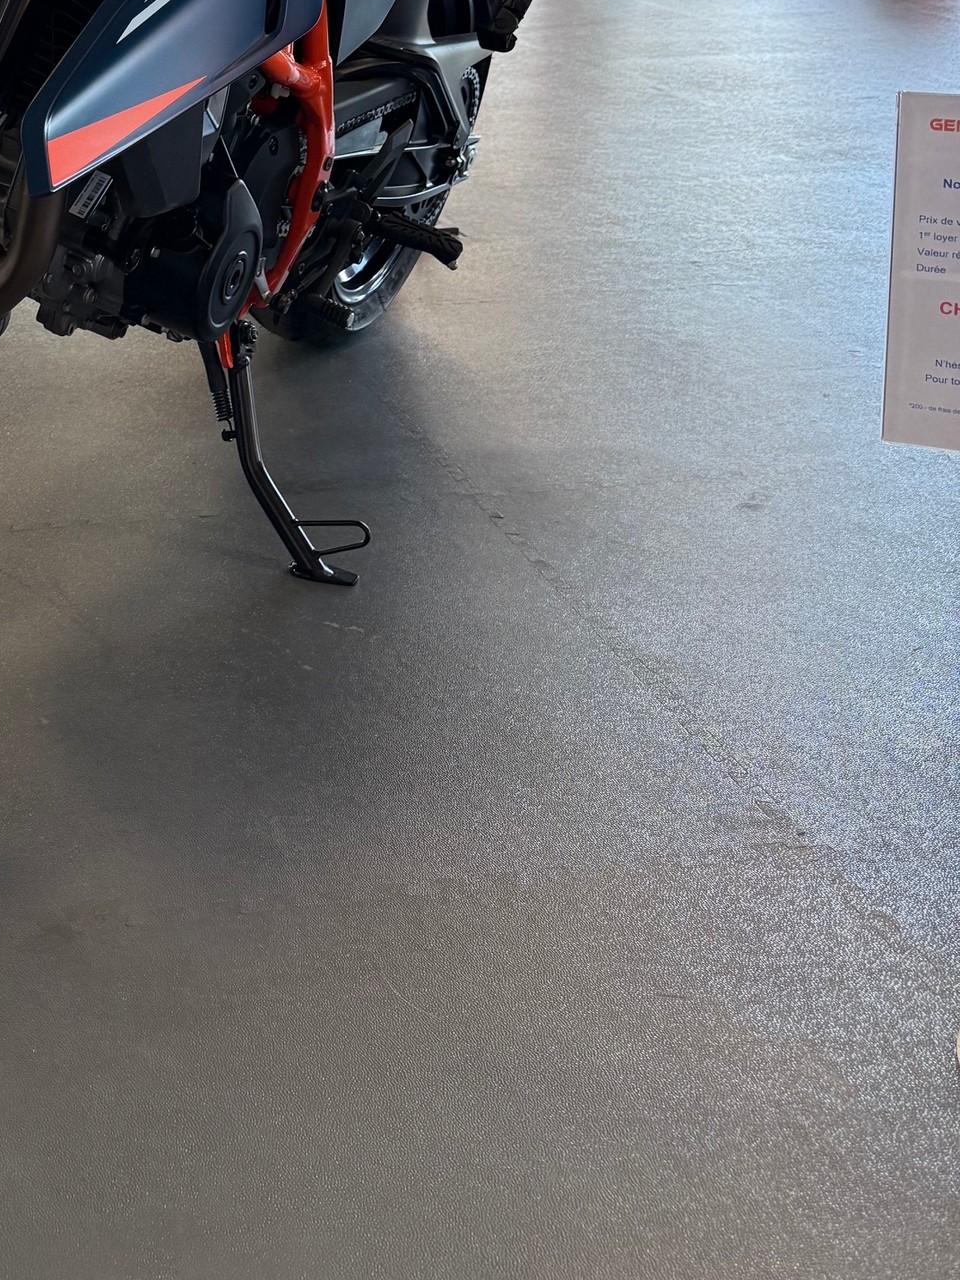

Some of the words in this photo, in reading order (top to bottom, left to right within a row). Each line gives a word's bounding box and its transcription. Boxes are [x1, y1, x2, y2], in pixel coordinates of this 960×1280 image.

[929, 118, 960, 132] GE
[919, 214, 938, 224] Prix
[941, 217, 953, 226] de
[933, 233, 958, 243] loyer
[917, 248, 949, 258] Valeur
[916, 263, 946, 274] Durée
[925, 373, 948, 384] Pour
